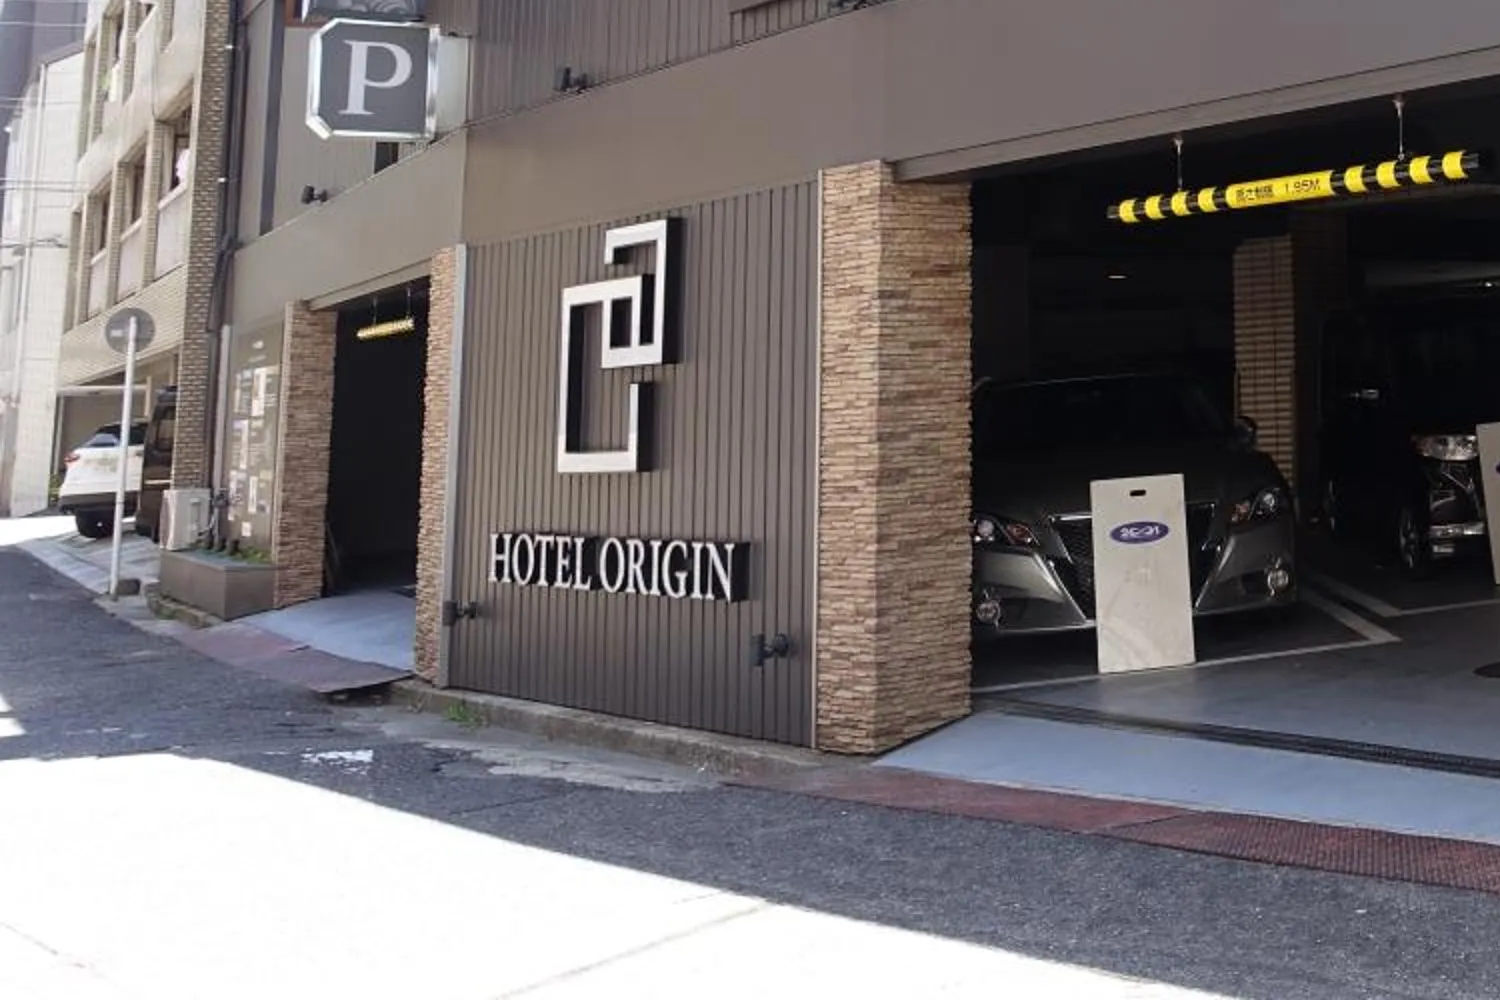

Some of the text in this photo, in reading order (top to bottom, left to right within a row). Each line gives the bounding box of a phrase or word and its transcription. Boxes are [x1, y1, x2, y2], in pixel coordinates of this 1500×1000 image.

[338, 39, 413, 115] P
[488, 531, 736, 604] HOTEL ORIGIN
